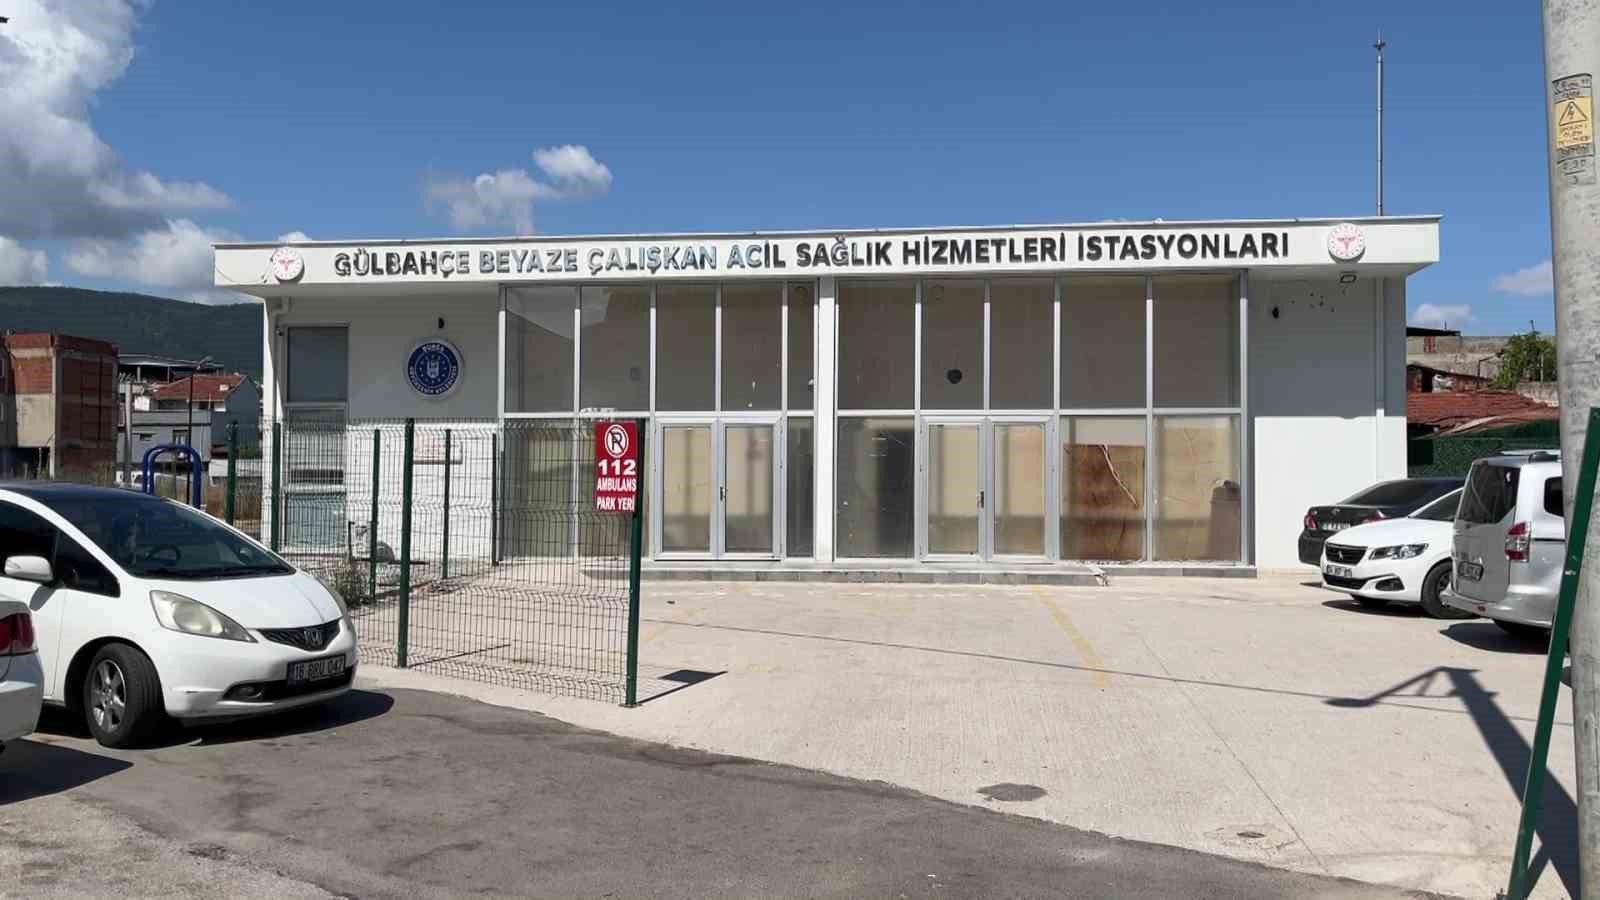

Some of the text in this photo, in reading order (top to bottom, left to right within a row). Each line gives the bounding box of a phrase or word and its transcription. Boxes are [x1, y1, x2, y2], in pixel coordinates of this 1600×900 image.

[334, 248, 470, 277] GÜLBAHÇE
[479, 249, 578, 273] BEYAZE
[587, 245, 718, 275] ÇALIŞKAN
[726, 240, 786, 268] ACİL
[796, 235, 892, 267] SAĞLIK
[902, 233, 1066, 265] HİZMETLERİ
[1078, 232, 1289, 261] İSTASYONLARI
[598, 459, 636, 476] 112
[597, 477, 637, 492] AMBULANS
[596, 496, 615, 510] PARK
